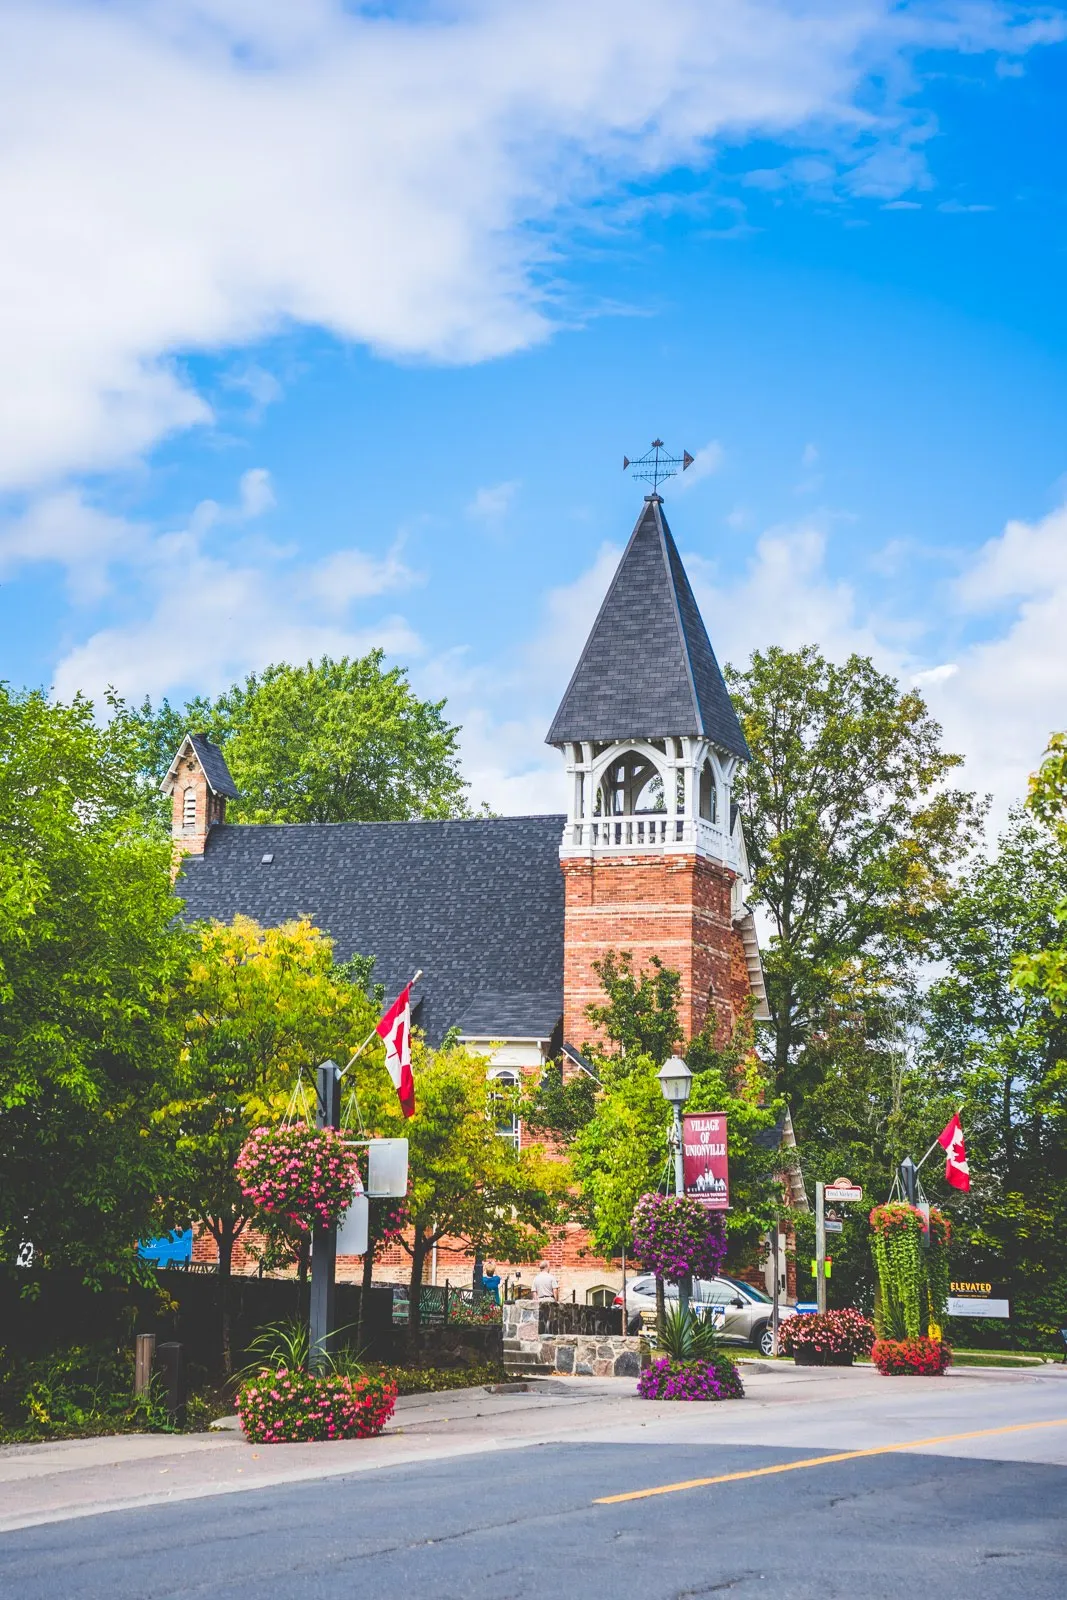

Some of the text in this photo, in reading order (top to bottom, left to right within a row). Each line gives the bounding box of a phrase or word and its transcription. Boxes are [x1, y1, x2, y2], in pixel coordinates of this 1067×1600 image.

[690, 1119, 720, 1131] VILLAGE
[700, 1131, 710, 1144] OF
[684, 1143, 726, 1157] UNIONVILLE
[950, 1282, 992, 1291] ELEVATED
